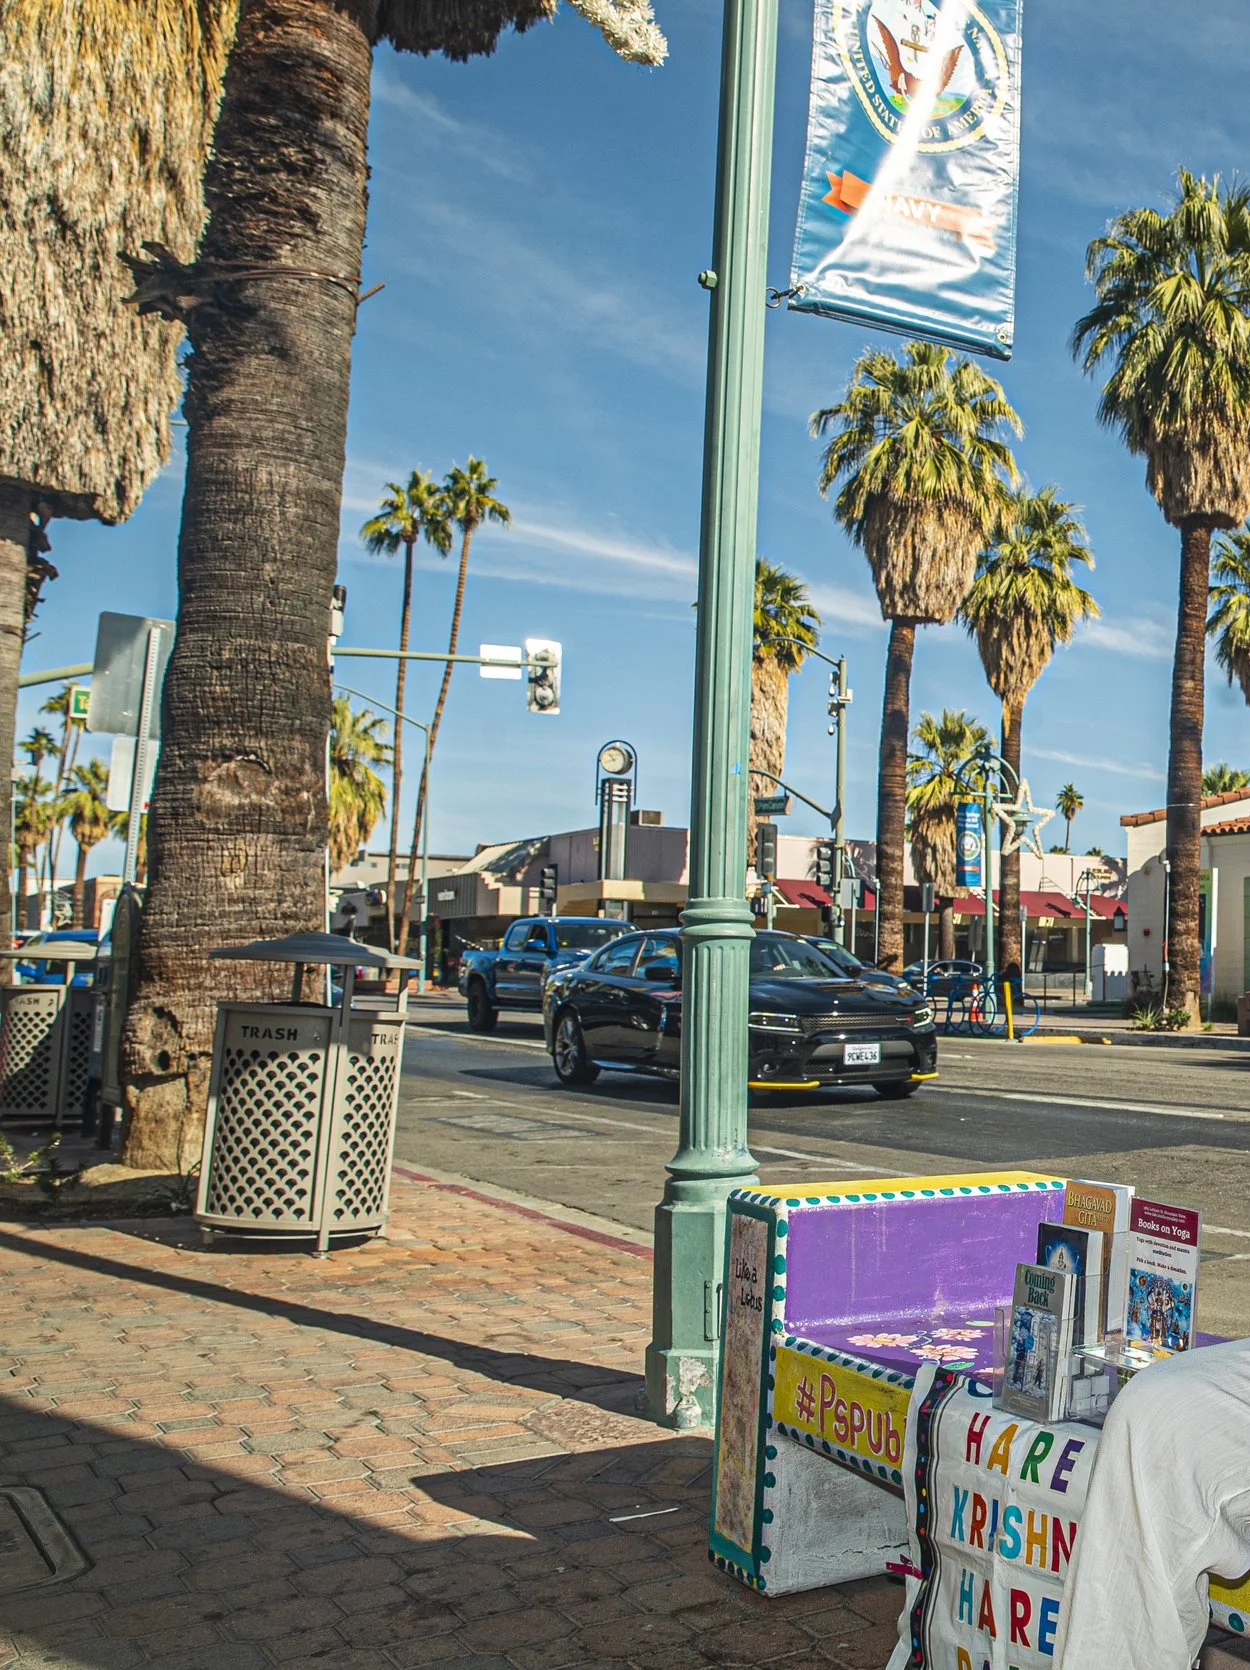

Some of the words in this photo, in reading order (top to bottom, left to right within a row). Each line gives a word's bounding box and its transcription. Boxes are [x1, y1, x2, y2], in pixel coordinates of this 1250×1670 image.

[872, 94, 902, 132] STAT
[241, 1025, 298, 1041] TRASH
[371, 1033, 398, 1045] TRAS
[1067, 1190, 1112, 1214] BHAGAVAD
[1138, 1218, 1160, 1232] Books
[1160, 1225, 1170, 1234] on
[1171, 1225, 1190, 1240] Yoga
[751, 1267, 757, 1283] a
[1025, 1269, 1056, 1294] Coming
[1028, 1286, 1049, 1307] Back
[795, 1373, 906, 1464] #Pspub
[965, 1412, 1086, 1493] HARE
[950, 1486, 1078, 1573] KRISHN
[959, 1568, 1060, 1657] HARE
